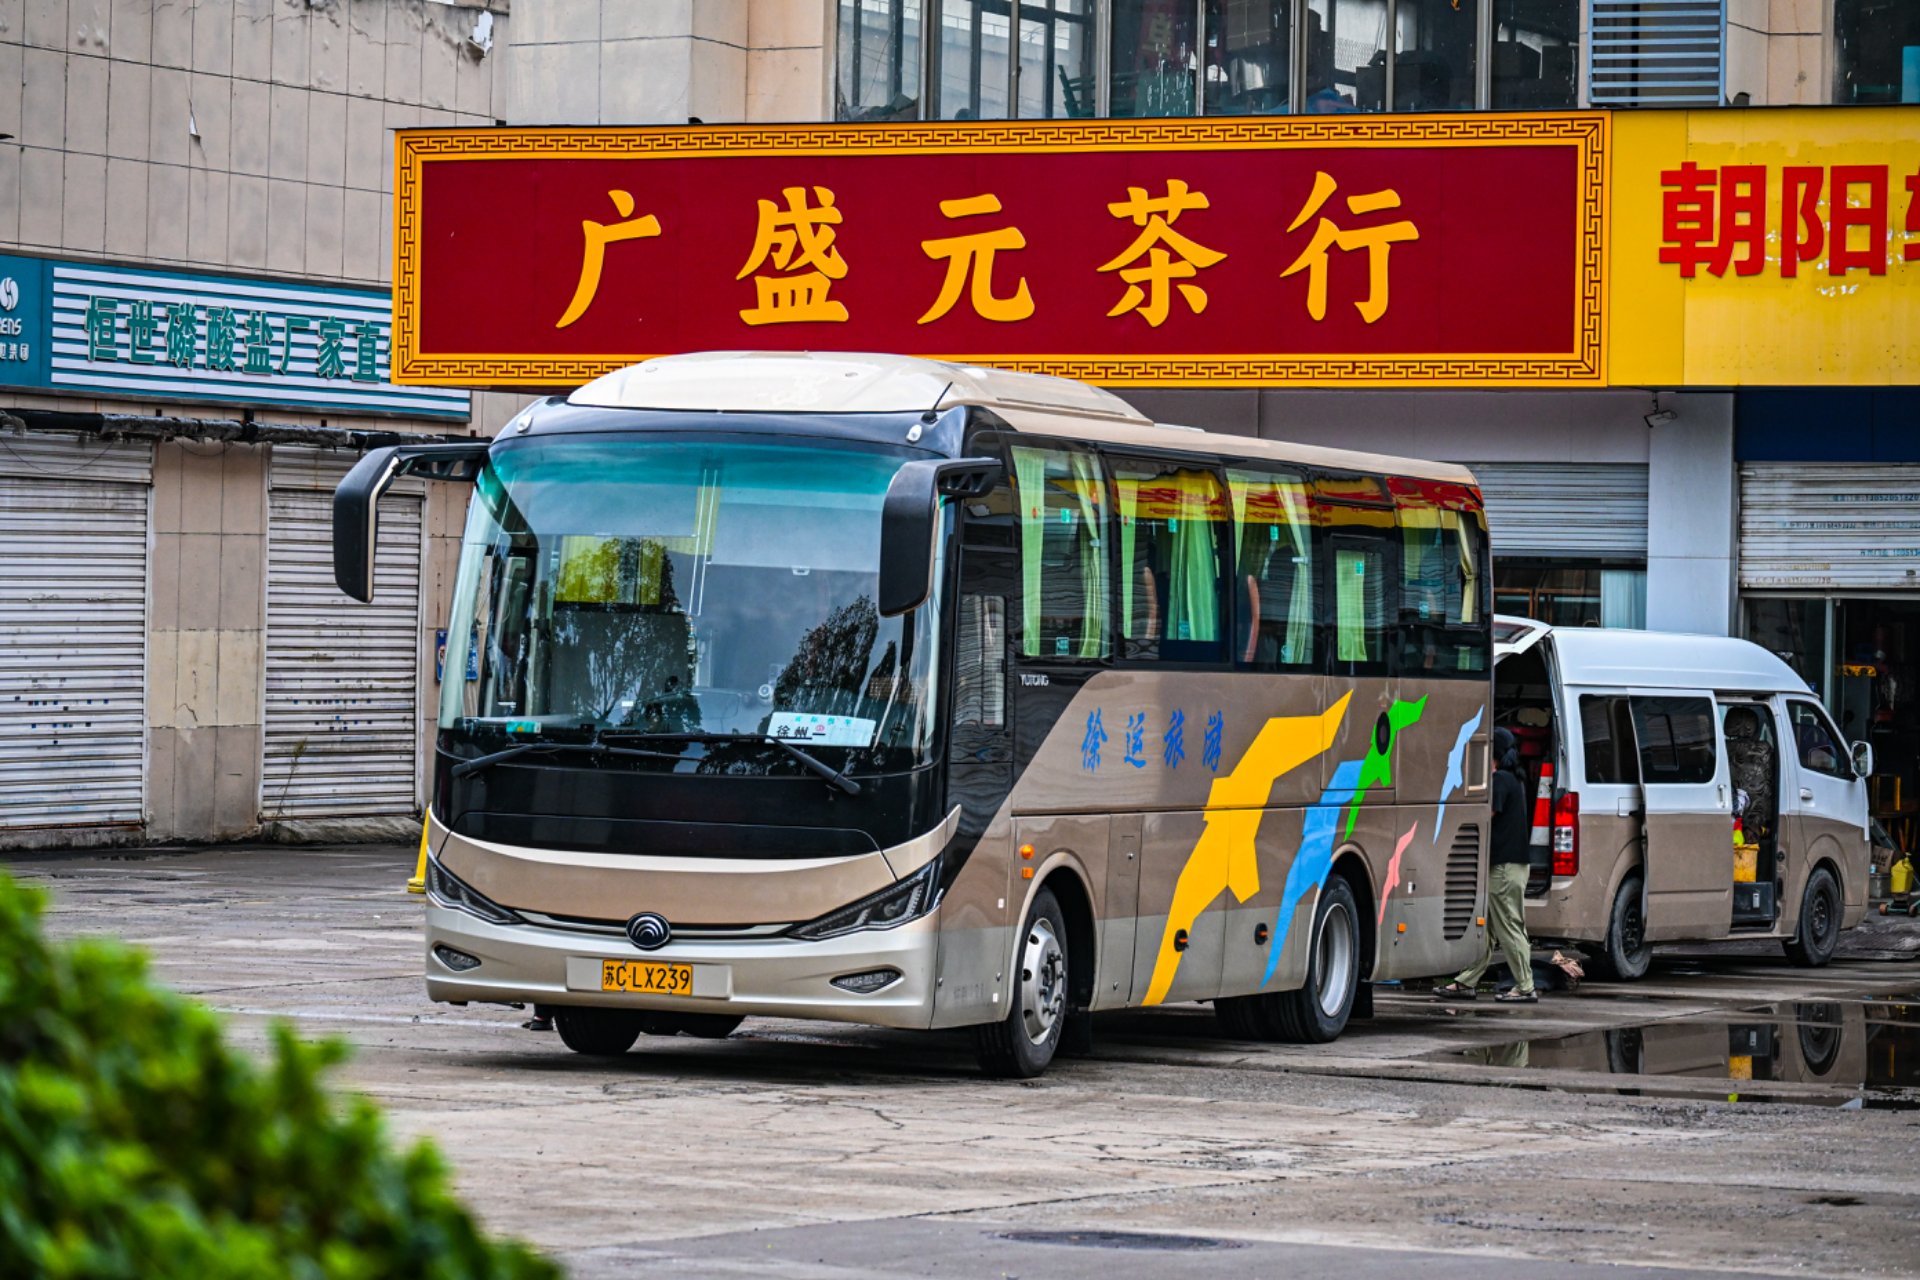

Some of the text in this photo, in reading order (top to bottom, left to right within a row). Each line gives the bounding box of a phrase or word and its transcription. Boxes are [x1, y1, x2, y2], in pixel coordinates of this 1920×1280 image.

[555, 170, 1420, 328] 广盛元茶行
[1658, 161, 1920, 278] 朝阳
[84, 294, 392, 383] 恒世磷酸盐厂家直
[776, 725, 808, 737] 徐州
